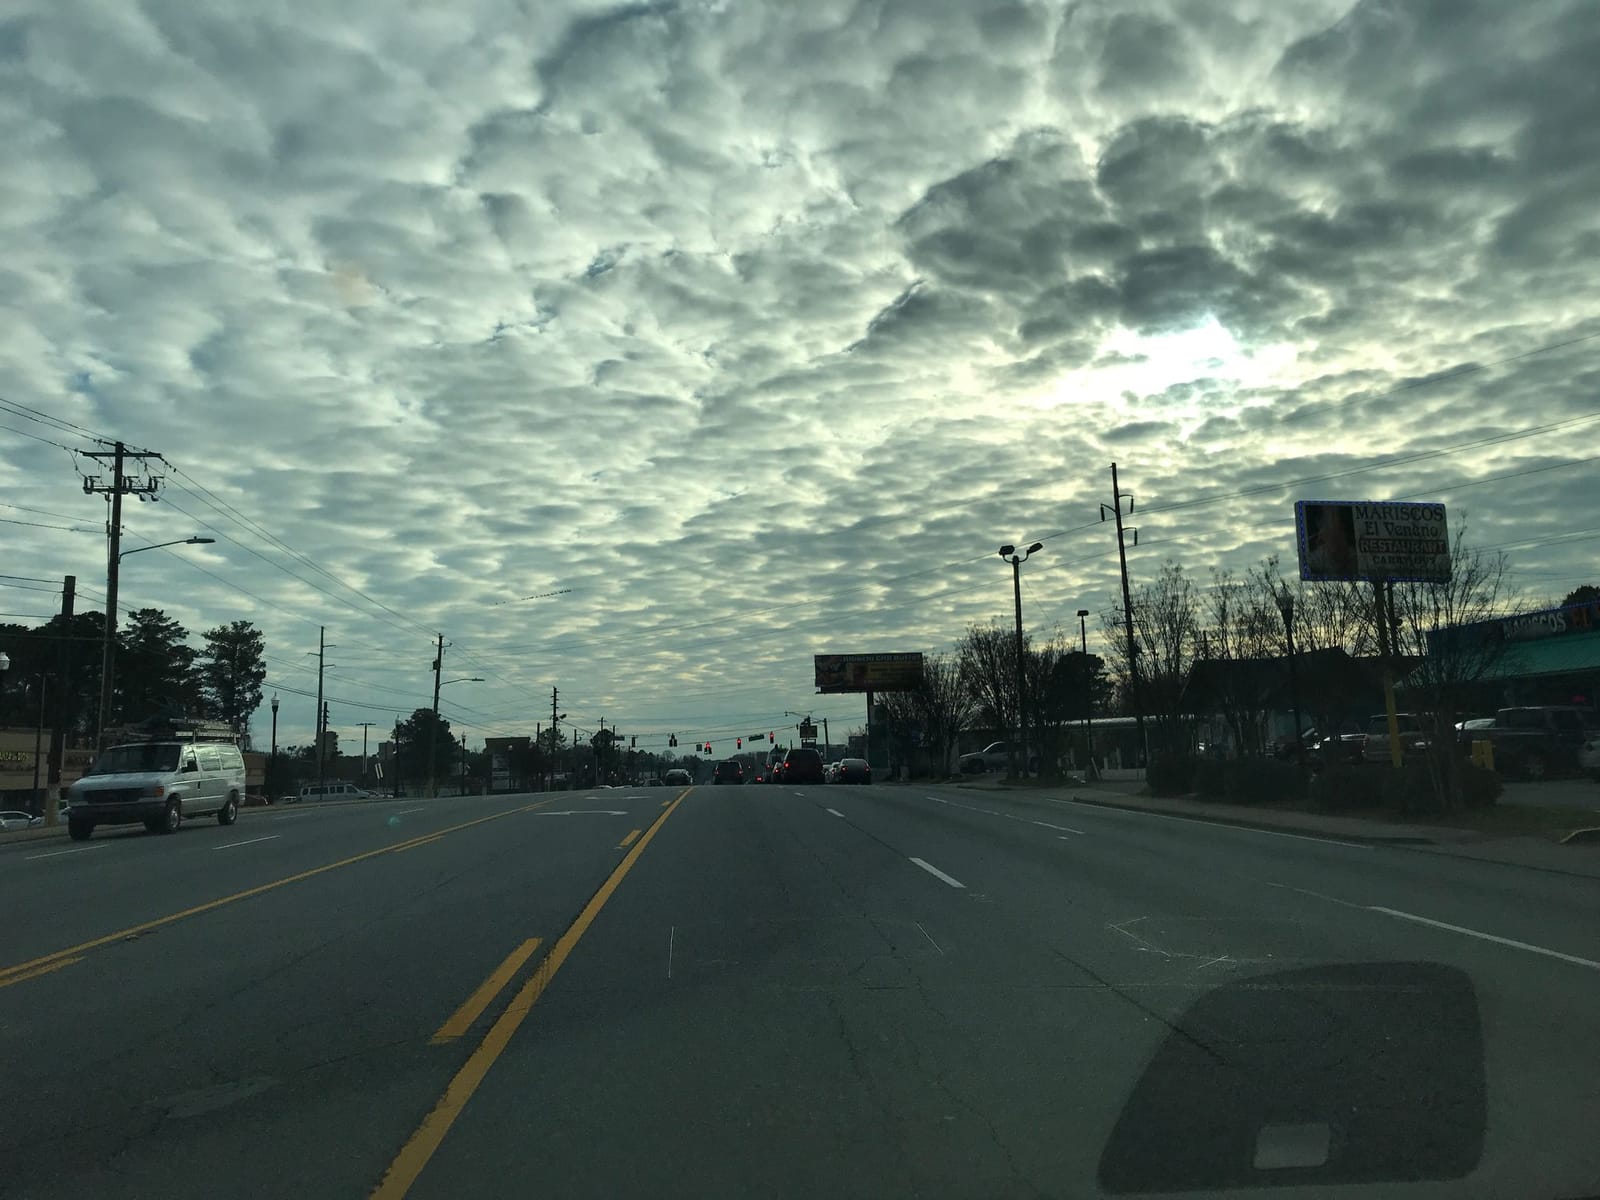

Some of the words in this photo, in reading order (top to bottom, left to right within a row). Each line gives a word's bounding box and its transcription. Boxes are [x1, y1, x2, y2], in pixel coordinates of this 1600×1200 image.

[1355, 506, 1443, 521] MARISCOS
[1365, 521, 1379, 536] El
[1360, 539, 1444, 553] RESTAURANT
